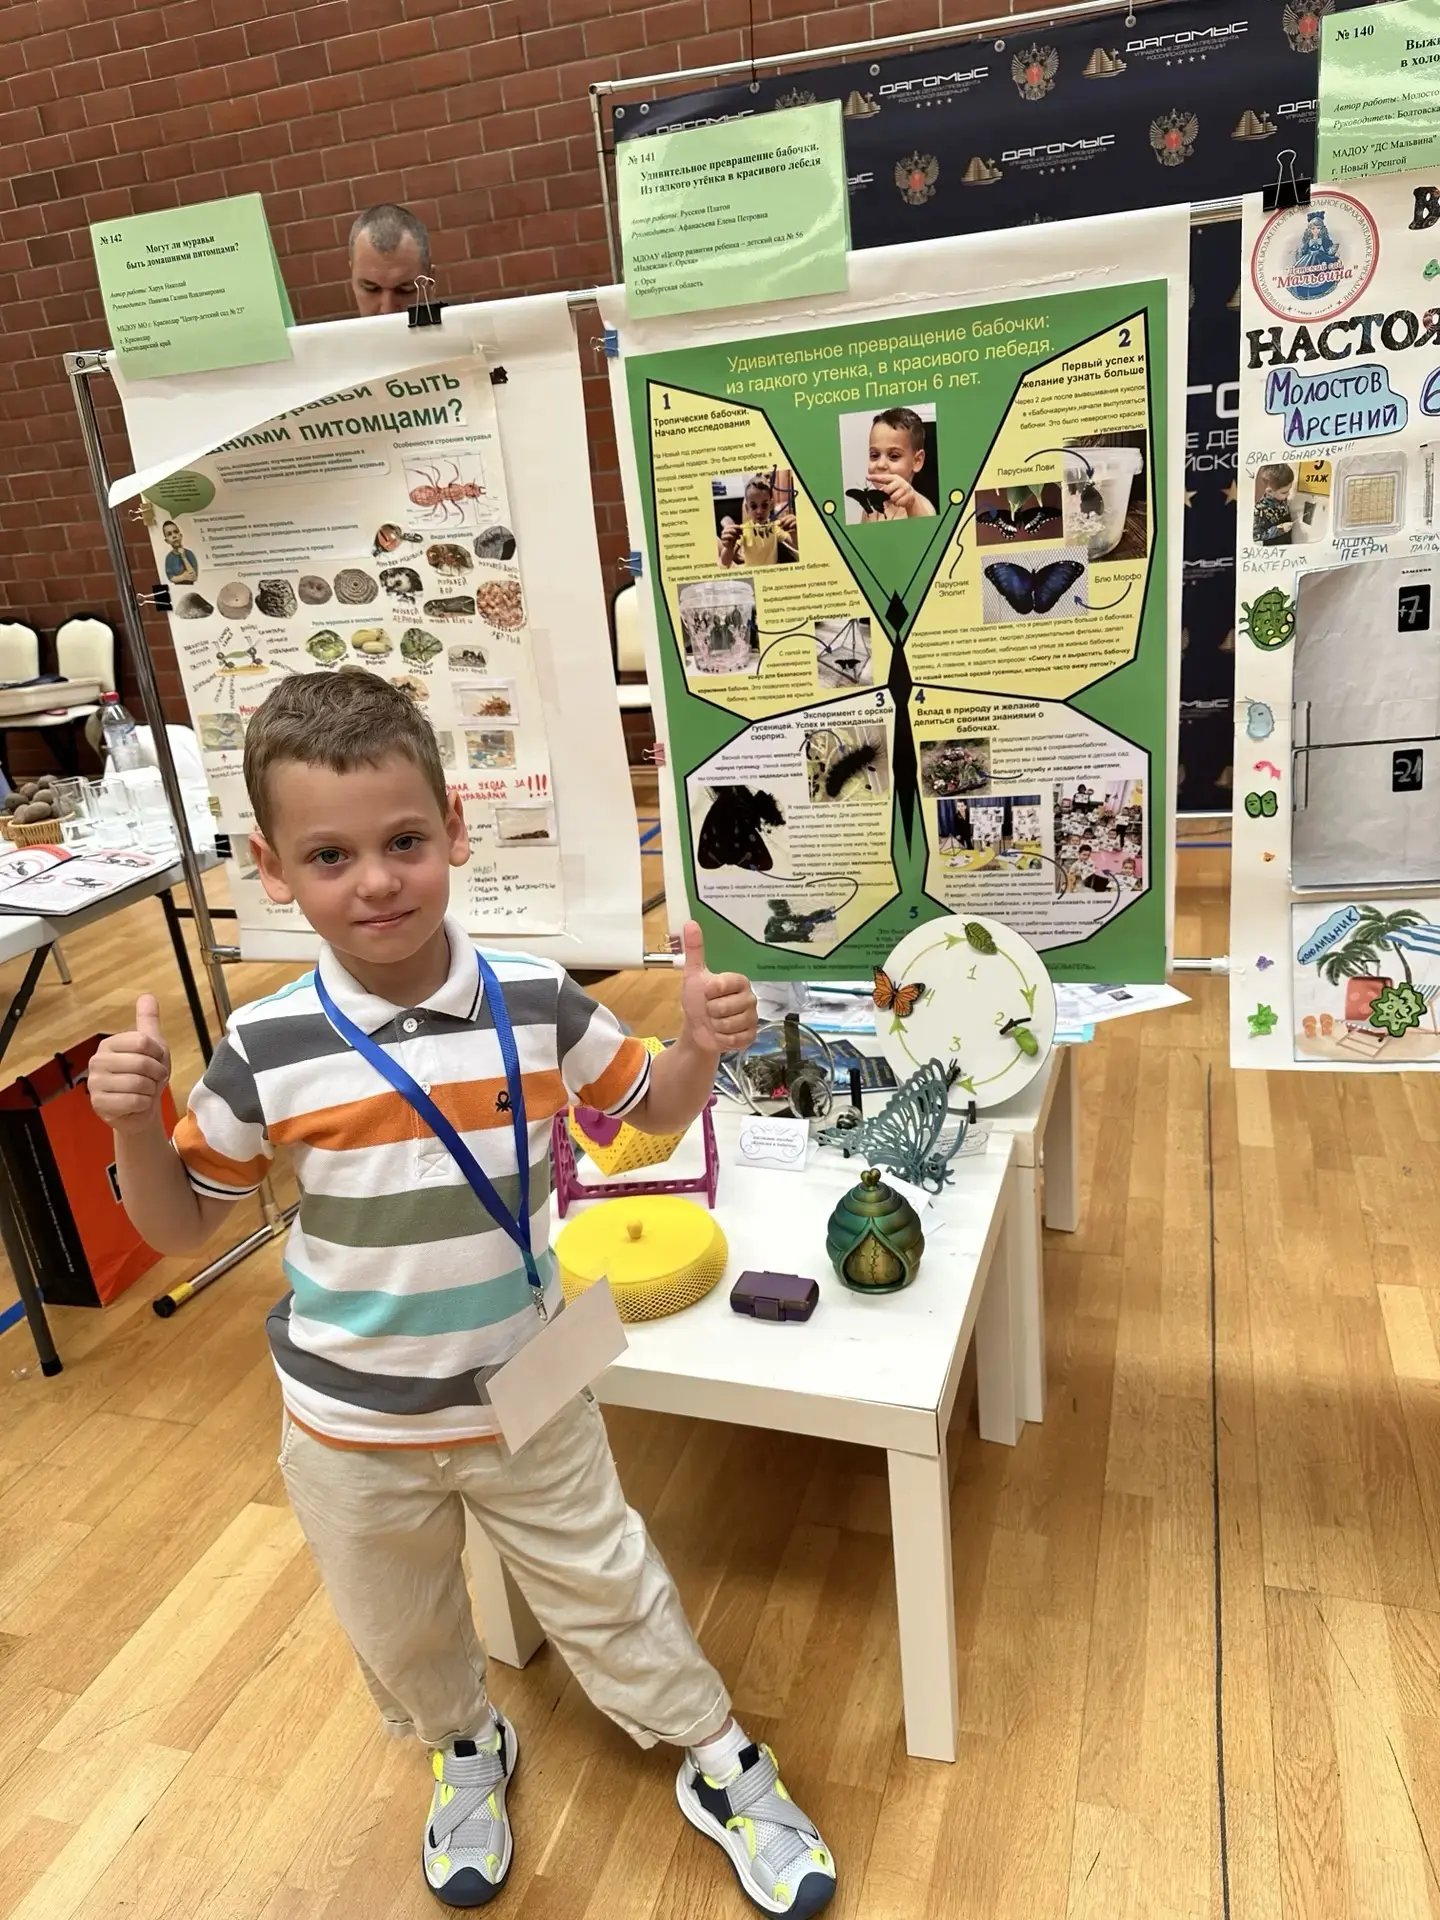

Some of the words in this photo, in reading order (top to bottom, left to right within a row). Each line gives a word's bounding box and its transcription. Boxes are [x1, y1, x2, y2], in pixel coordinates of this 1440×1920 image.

[1125, 21, 1249, 52] ДАГОМЫС
[1335, 29, 1349, 41] №
[1354, 24, 1374, 38] 140
[1400, 59, 1408, 67] в
[879, 67, 989, 95] ДАГОМЫС
[1333, 102, 1361, 112] Автор
[1361, 96, 1400, 110] работы:
[1332, 111, 1395, 130] Руководитель:
[1001, 134, 1115, 162] ДАГОМЫС
[1332, 144, 1368, 158] МАДОУ
[1370, 141, 1388, 153] "ДС
[1390, 134, 1437, 149] Мальвина"
[627, 155, 637, 165] №
[640, 151, 655, 163] 141
[640, 163, 707, 181] Удивительное
[709, 151, 774, 171] превращение
[775, 143, 819, 157] бабочки.
[1340, 161, 1368, 174] Новый
[1370, 155, 1406, 170] Уренгой
[640, 185, 652, 195] Из
[654, 180, 691, 192] гадкого
[692, 174, 725, 189] утёнка
[736, 164, 786, 180] красивого
[787, 157, 820, 170] лебедя
[678, 220, 715, 232] Афанасьева
[716, 217, 736, 226] Елена
[737, 212, 768, 222] Петровна
[100, 236, 108, 245] №
[109, 233, 122, 243] 142
[145, 243, 169, 253] Могут
[171, 241, 181, 249] ли
[182, 235, 214, 248] муравьи
[632, 252, 659, 263] МДОАУ
[660, 250, 684, 258] «Центр
[684, 246, 713, 257] развития
[714, 242, 739, 253] ребенка
[746, 236, 772, 247] детский
[785, 232, 794, 240] №
[795, 230, 804, 238] 56
[126, 261, 146, 270] быть
[146, 252, 191, 266] домашними
[192, 242, 238, 258] питомцами?
[640, 277, 656, 286] Орск
[1272, 264, 1358, 289] "Мальвина"
[634, 284, 678, 296] Оренбургская
[678, 281, 703, 289] область
[121, 341, 159, 353] Краснодарский
[159, 339, 171, 348] край
[726, 344, 843, 374] Удивительное
[848, 327, 966, 358] превращение
[971, 315, 1049, 338] бабочки:
[1118, 328, 1131, 348] 2
[726, 381, 744, 395] из
[748, 372, 807, 392] гадкого
[812, 364, 872, 387] утенка,
[878, 361, 888, 374] в
[892, 348, 979, 375] красивого
[984, 339, 1054, 360] лебедя.
[1061, 358, 1102, 372] Первый
[1105, 355, 1134, 368] успех
[1137, 354, 1144, 362] и
[386, 373, 460, 398] быть
[1020, 376, 1064, 388] желание
[1066, 372, 1101, 385] узнать
[1103, 366, 1144, 378] больше
[794, 387, 860, 410] Руссков
[865, 378, 927, 398] Платон
[932, 372, 943, 389] 6
[948, 371, 980, 387] лет.
[1013, 396, 1034, 405] Через
[1040, 395, 1052, 403] дня
[1120, 384, 1145, 393] куколок
[662, 393, 671, 410] 1
[299, 398, 462, 441] питомцами?
[653, 413, 708, 428] Тропические
[710, 408, 750, 419] бабочки.
[1019, 422, 1045, 430] бабочки.
[1080, 413, 1118, 422] невероятно
[1119, 410, 1145, 419] красиво
[654, 427, 686, 437] Начало
[687, 419, 750, 433] исследования
[392, 439, 434, 449] Особенности
[434, 436, 464, 444] строения
[464, 433, 491, 442] муравья
[1246, 452, 1276, 465] ВРАГ
[997, 466, 1033, 476] Парусник
[1034, 463, 1055, 472] Лови
[1306, 474, 1328, 482] ЭТАЖ
[1332, 537, 1375, 549] ЧАШКА
[1242, 548, 1287, 559] ЗАХВАТ
[1341, 544, 1388, 561] ПЕТРИ
[1243, 556, 1308, 573] БАКТЕРИЙ
[934, 580, 969, 589] Парусник
[1094, 575, 1112, 583] Блю
[1112, 572, 1142, 581] Морфо
[876, 692, 885, 707] 3
[914, 688, 926, 704] 4
[802, 710, 855, 719] Эксперимент
[864, 706, 893, 716] орской
[916, 708, 944, 716] Вклад
[953, 705, 991, 715] природу
[1001, 702, 1040, 710] желание
[751, 720, 793, 733] гусеницей.
[827, 716, 884, 726] неожиданный
[913, 717, 954, 727] делиться
[956, 715, 990, 723] своими
[992, 712, 1036, 721] знаниями
[750, 732, 786, 741] сюрприз.
[956, 724, 999, 733] бабочках.
[909, 906, 918, 919] 5
[966, 964, 978, 980] 1
[924, 988, 936, 1006] 4
[994, 1012, 1004, 1027] 2
[949, 1036, 962, 1052] 3
